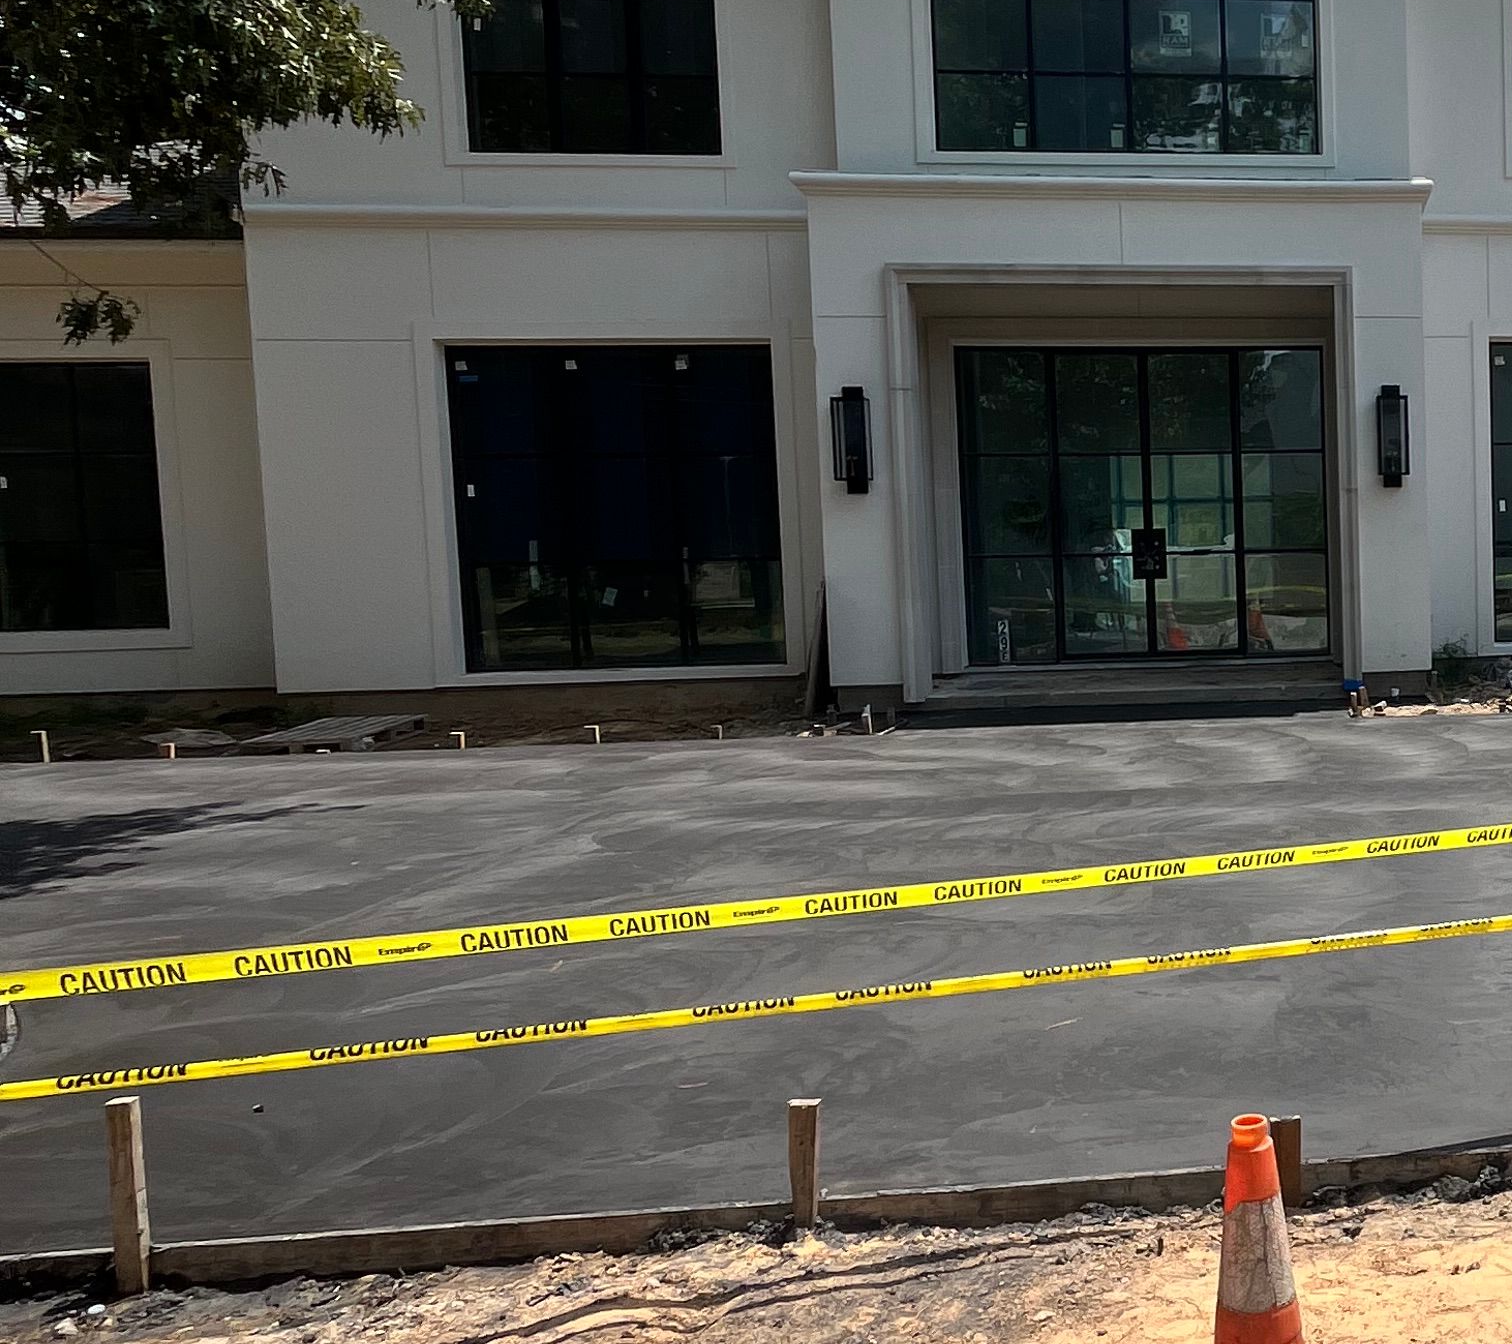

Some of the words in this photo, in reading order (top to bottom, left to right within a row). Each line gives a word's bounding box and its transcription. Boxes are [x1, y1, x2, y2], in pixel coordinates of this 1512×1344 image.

[60, 962, 187, 996] CAUTION
[234, 946, 353, 976] CAUTION
[460, 924, 568, 953] CAUTION
[609, 911, 710, 937] CAUTION
[805, 891, 897, 915] CAUTION
[934, 879, 1022, 901] CAUTION
[1104, 862, 1185, 882] CAUTION
[1217, 850, 1295, 870] CAUTION
[1367, 835, 1440, 854] CAUTION
